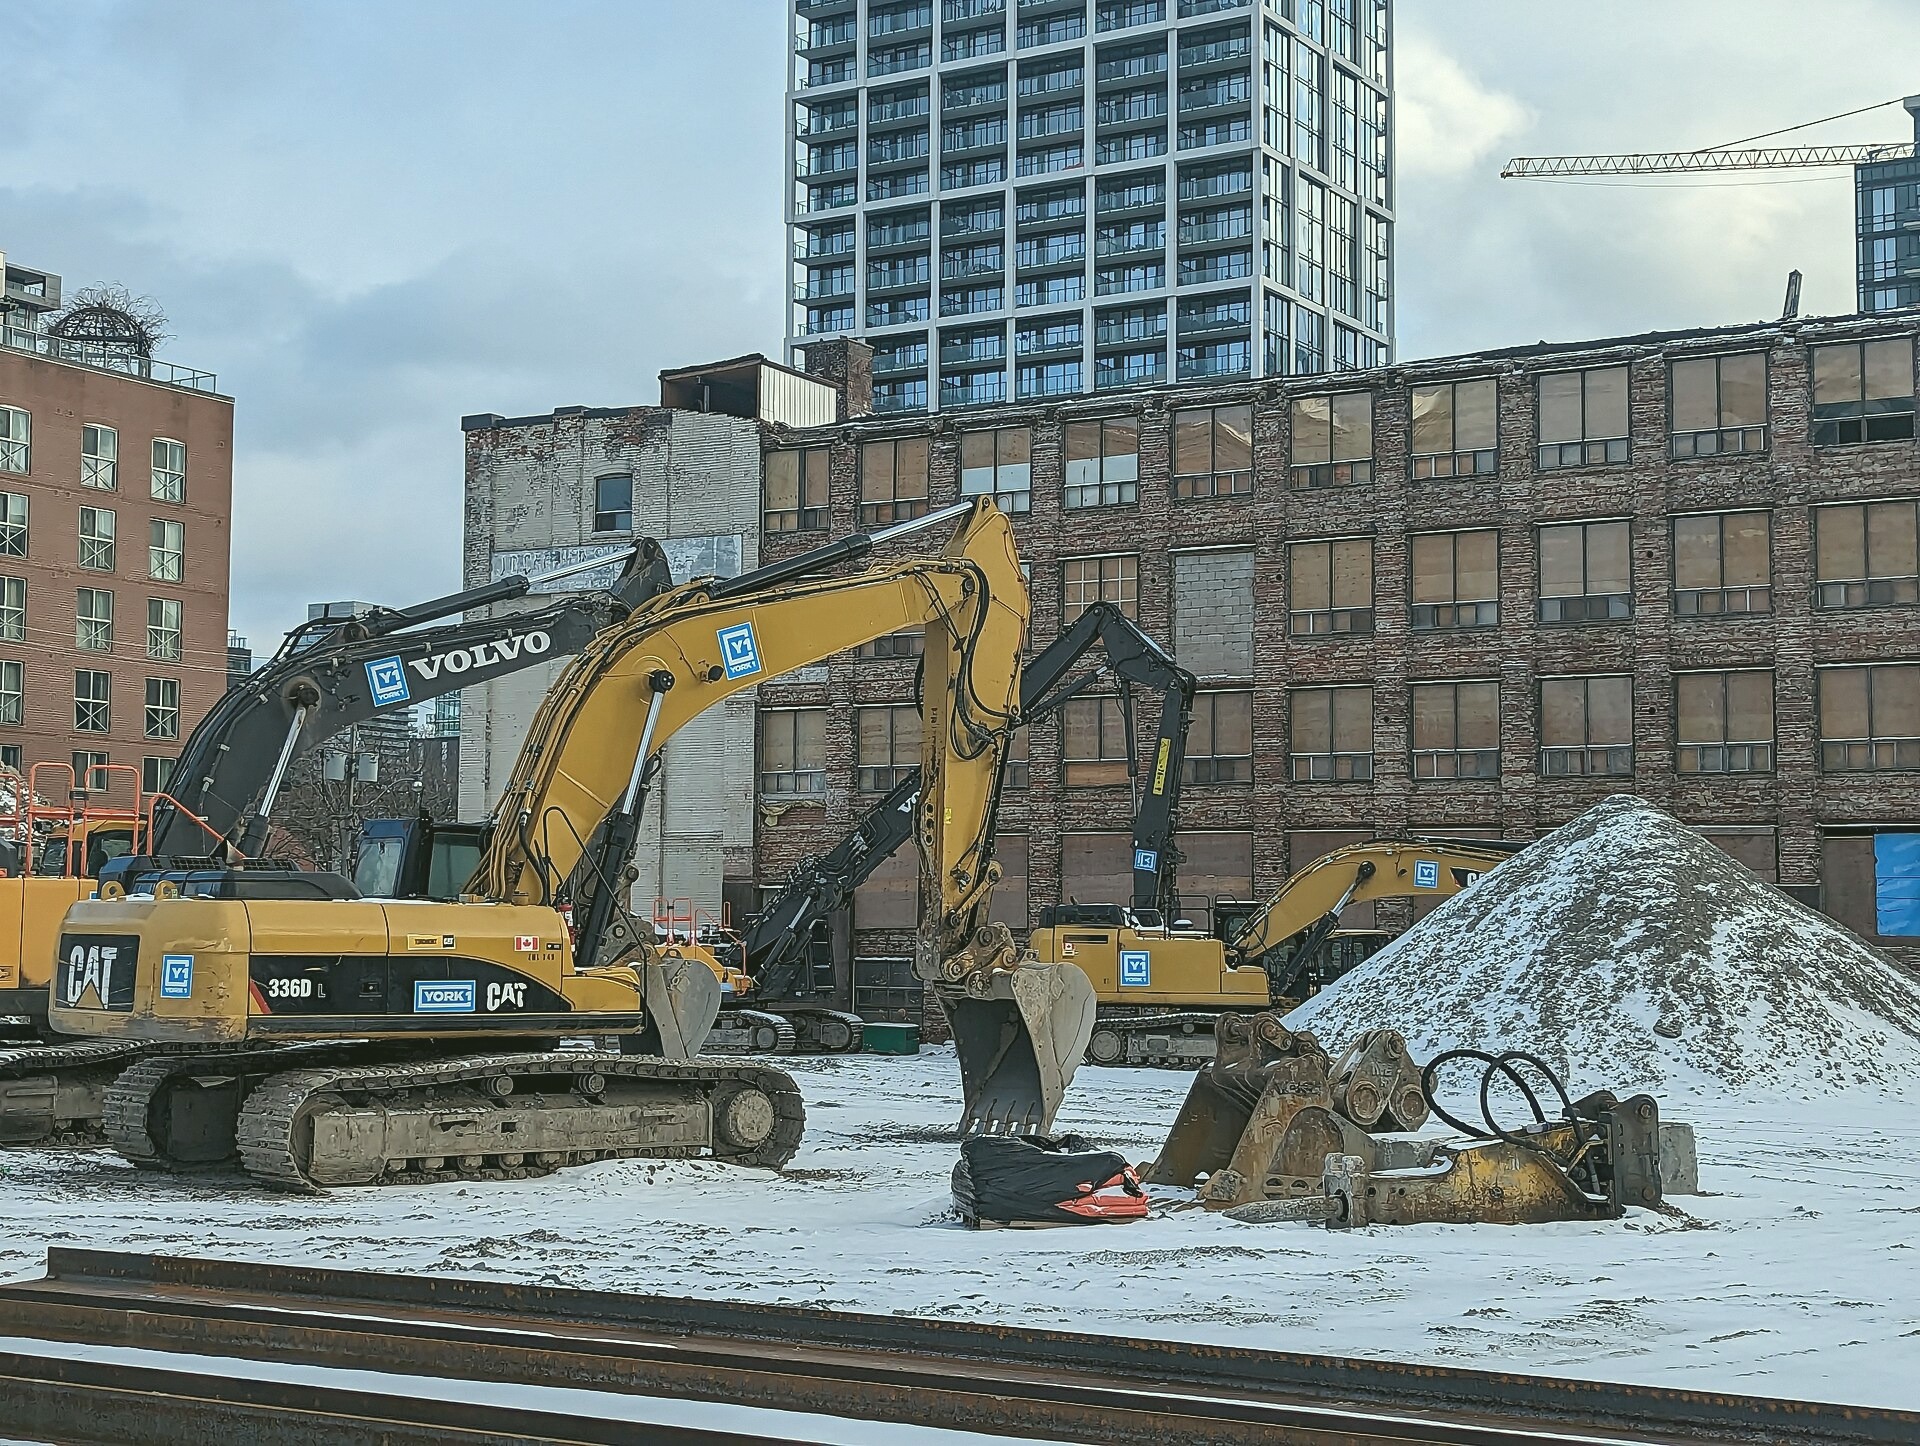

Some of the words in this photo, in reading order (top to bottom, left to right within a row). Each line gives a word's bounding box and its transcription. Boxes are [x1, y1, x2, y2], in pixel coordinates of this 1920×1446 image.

[730, 637, 752, 654] Y1
[408, 631, 551, 680] VOLVO
[378, 668, 401, 684] Y1
[171, 967, 189, 979] Y1
[1129, 961, 1146, 971] Y1
[67, 945, 118, 1010] CAT
[268, 978, 312, 998] 336D
[317, 983, 327, 998] L
[486, 982, 528, 1012] CAT
